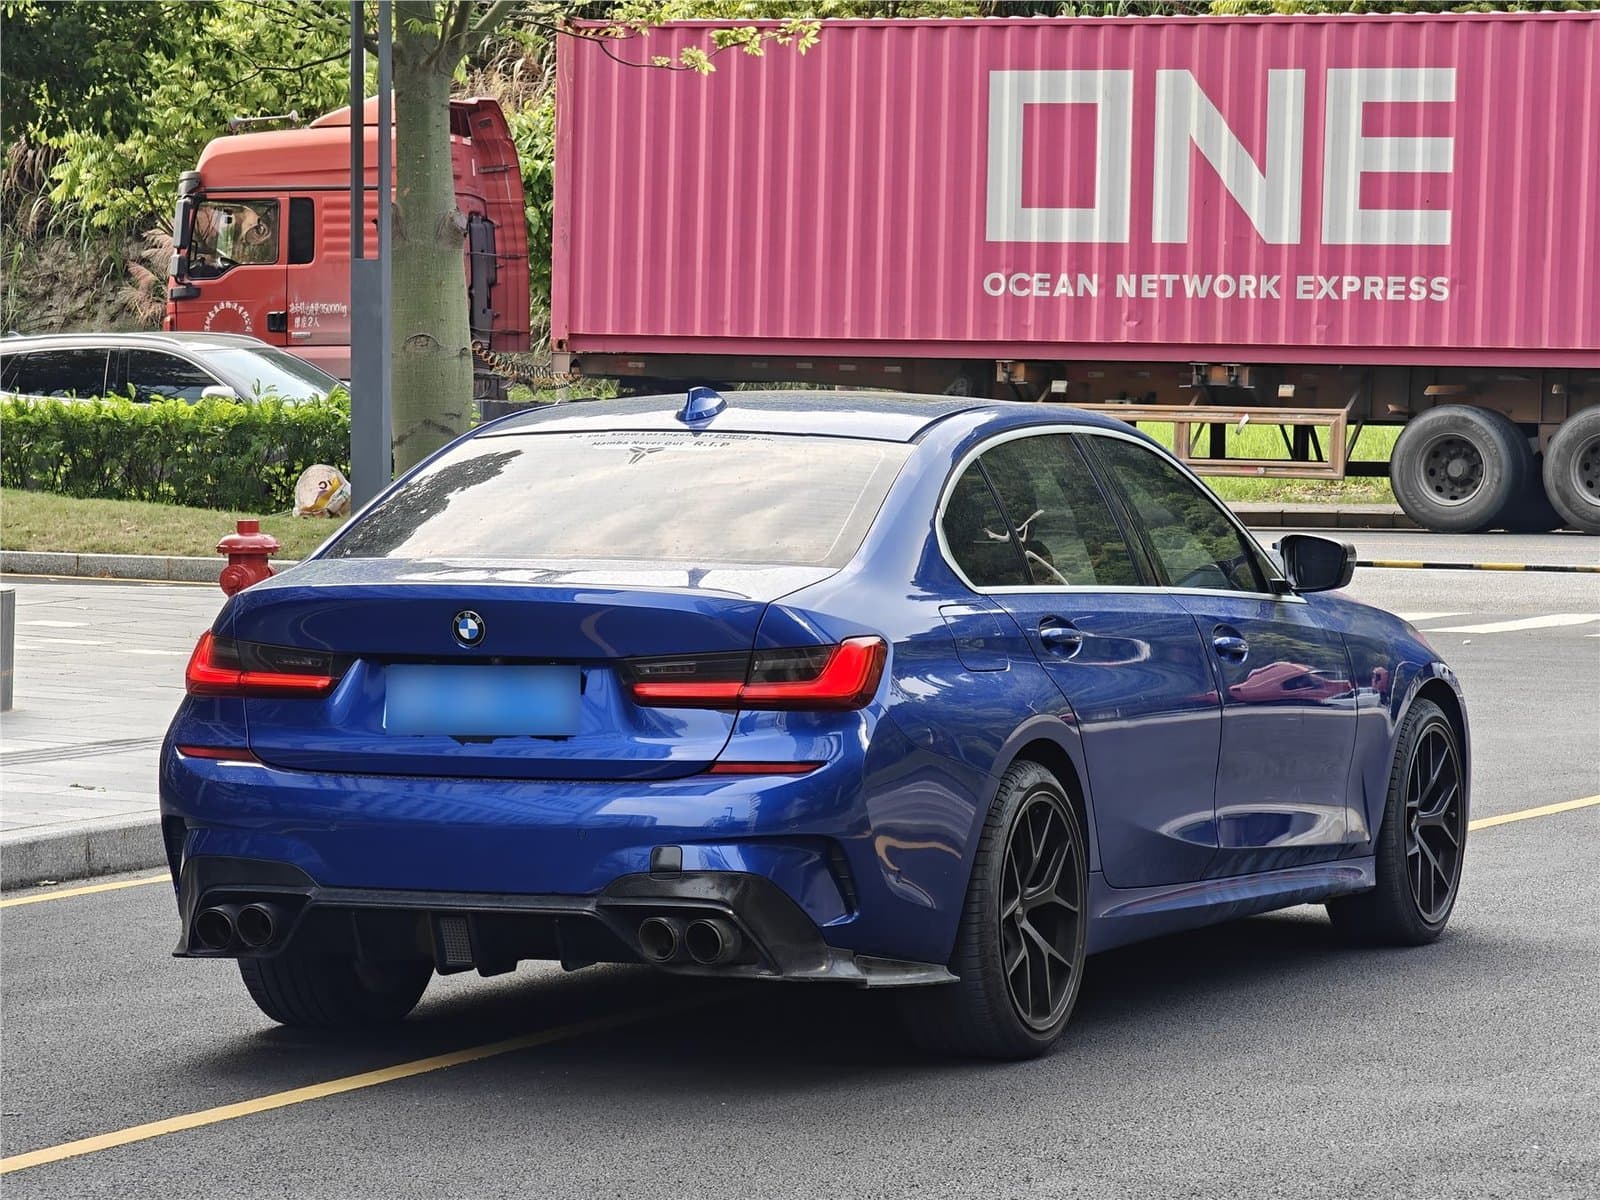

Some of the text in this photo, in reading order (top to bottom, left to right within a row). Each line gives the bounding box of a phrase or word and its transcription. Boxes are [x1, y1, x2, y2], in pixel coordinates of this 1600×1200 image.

[986, 68, 1456, 245] ONE
[982, 272, 1450, 302] OCEAN NETWORK EXPRESS
[592, 439, 630, 447] Mamba
[631, 439, 662, 447] Never
[455, 612, 482, 624] BMW
